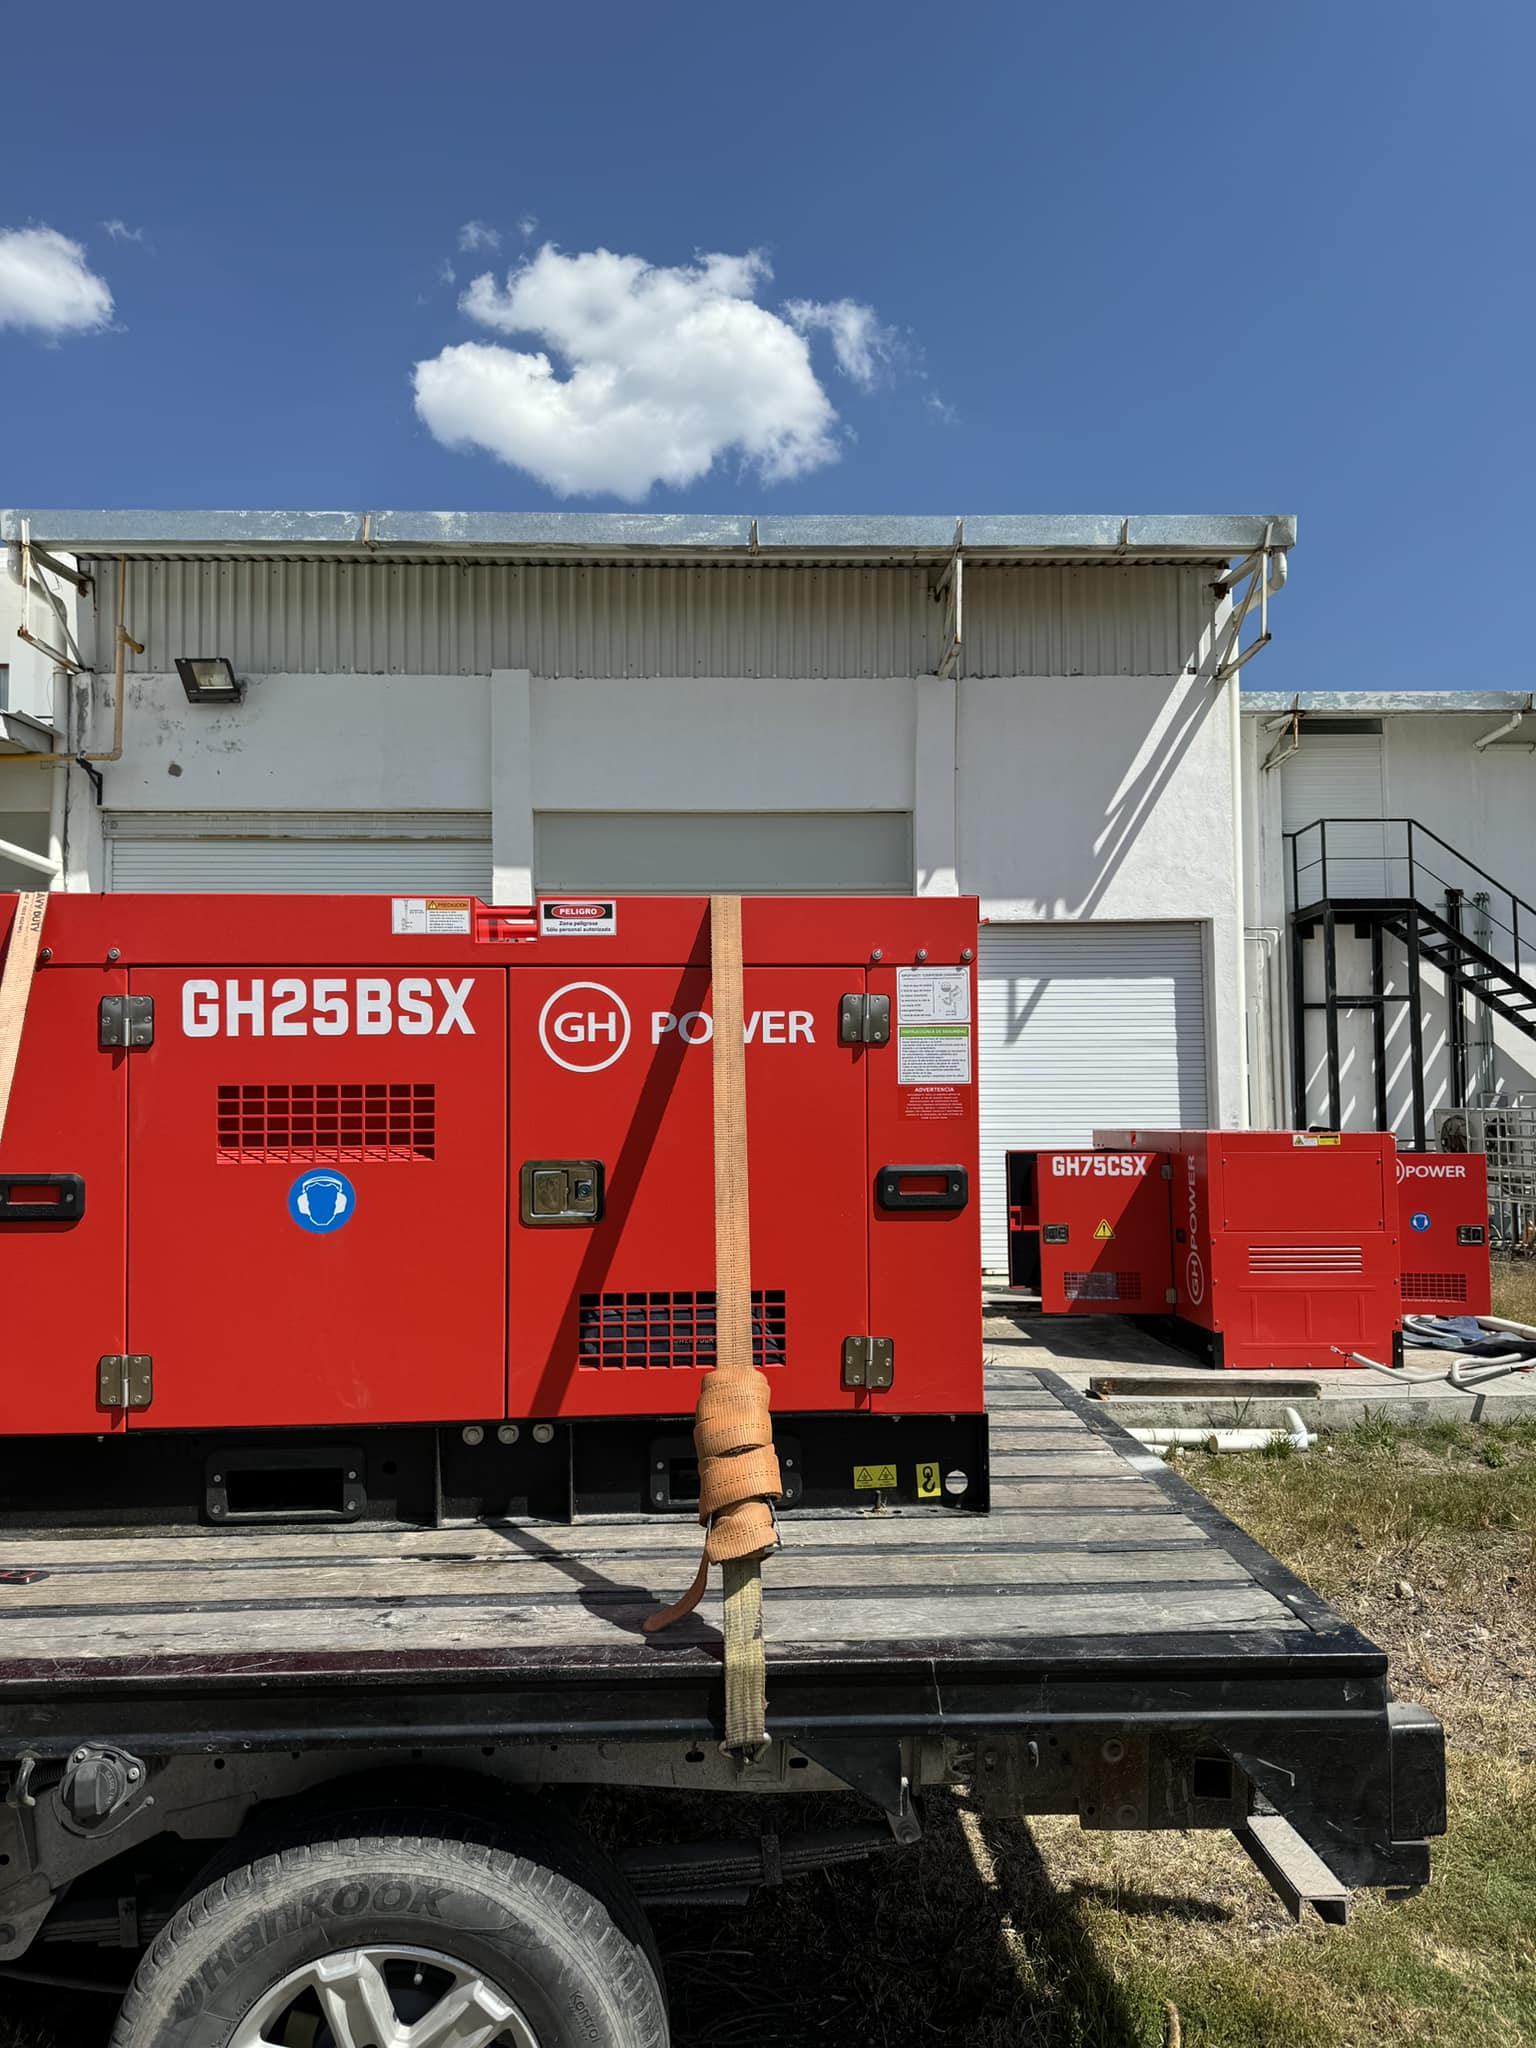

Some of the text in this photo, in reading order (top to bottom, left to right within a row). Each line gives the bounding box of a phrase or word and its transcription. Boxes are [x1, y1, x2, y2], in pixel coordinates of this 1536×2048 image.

[31, 893, 46, 932] AVY DUTY
[182, 978, 476, 1037] GH25BSX
[553, 1011, 617, 1043] GH
[1052, 1156, 1147, 1176] GH75CSX
[1405, 1165, 1466, 1178] POWER
[1187, 1154, 1199, 1297] GH POWER
